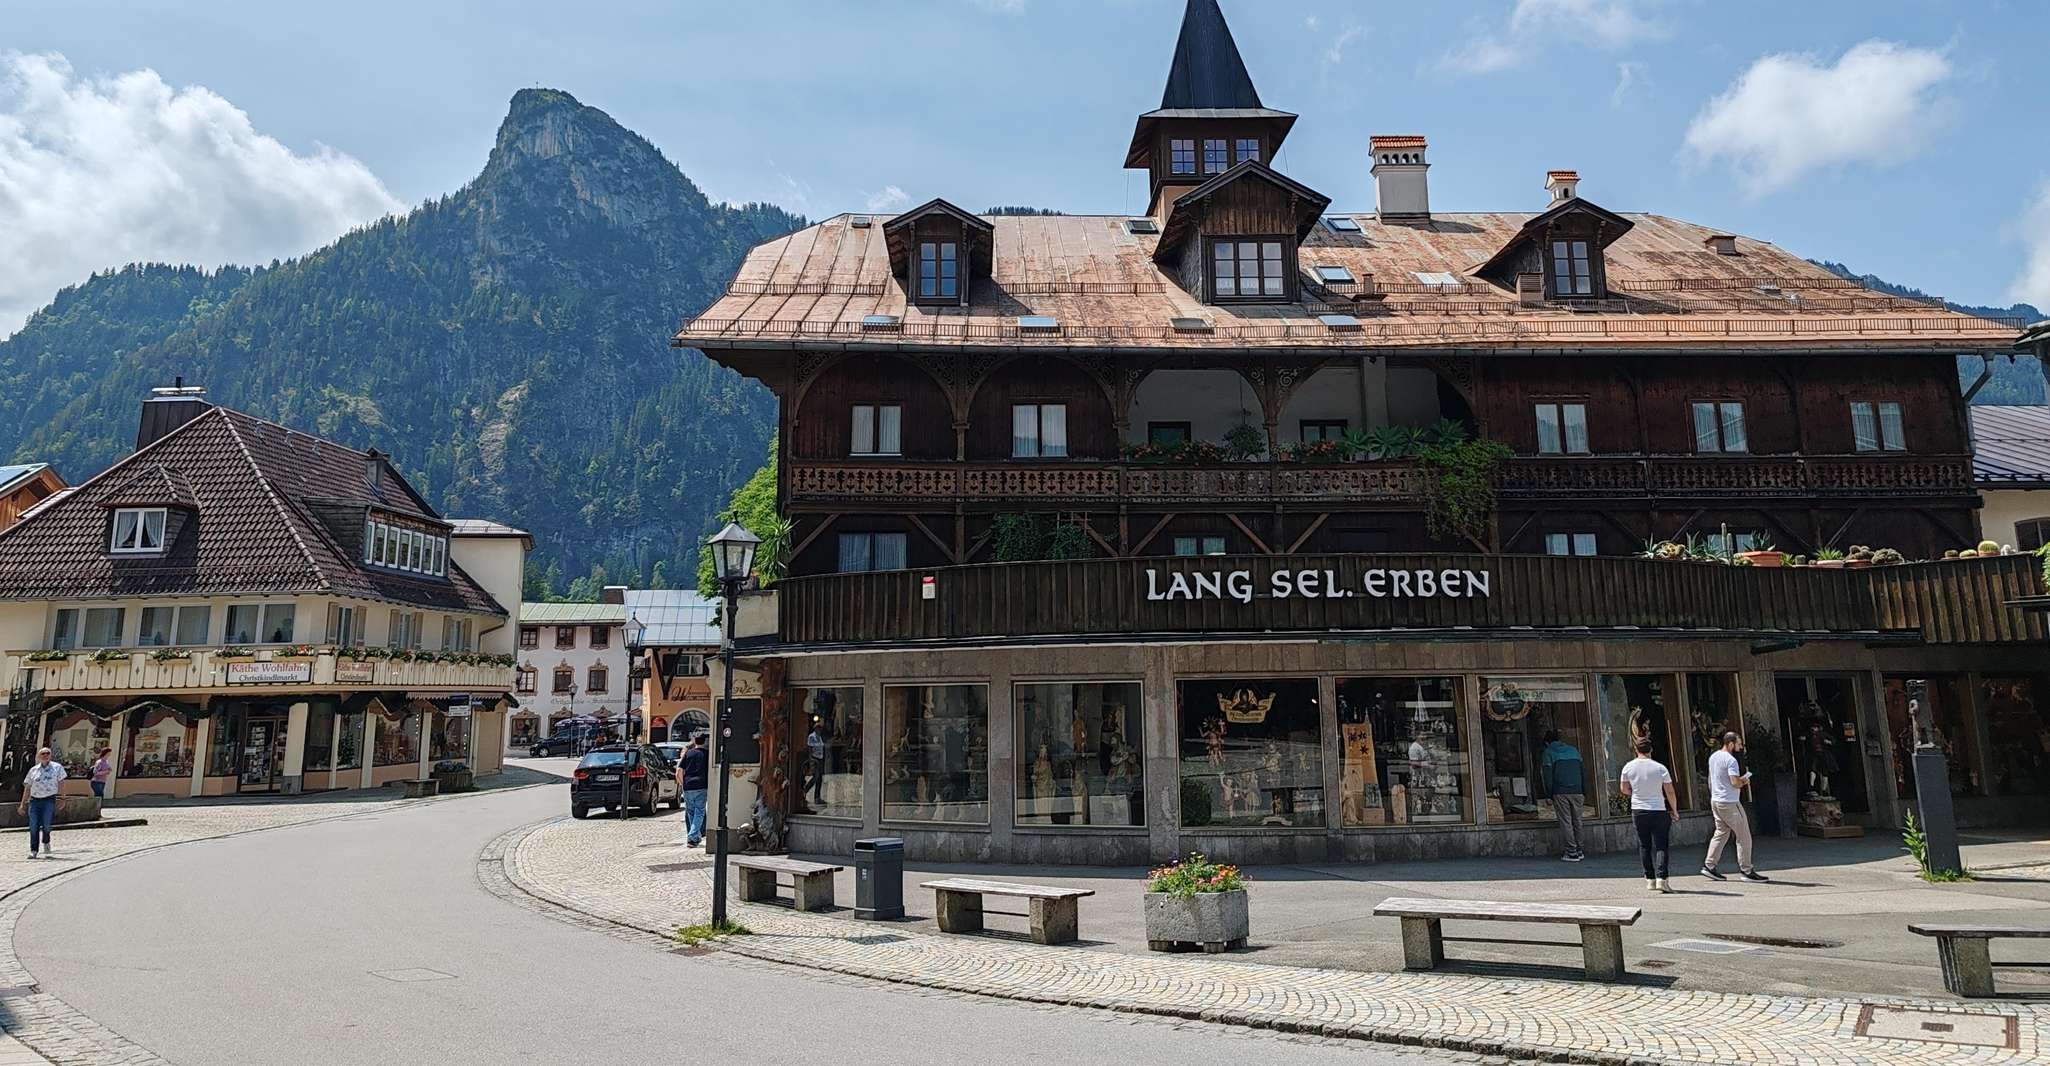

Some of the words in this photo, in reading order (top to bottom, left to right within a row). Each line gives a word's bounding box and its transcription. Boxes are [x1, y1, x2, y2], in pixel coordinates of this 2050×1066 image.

[1145, 569, 1253, 603] LANG
[1271, 568, 1353, 598] SEL.
[1363, 568, 1490, 598] ERBEN
[231, 663, 259, 673] Käthe
[239, 674, 298, 682] Christkindlmarkt
